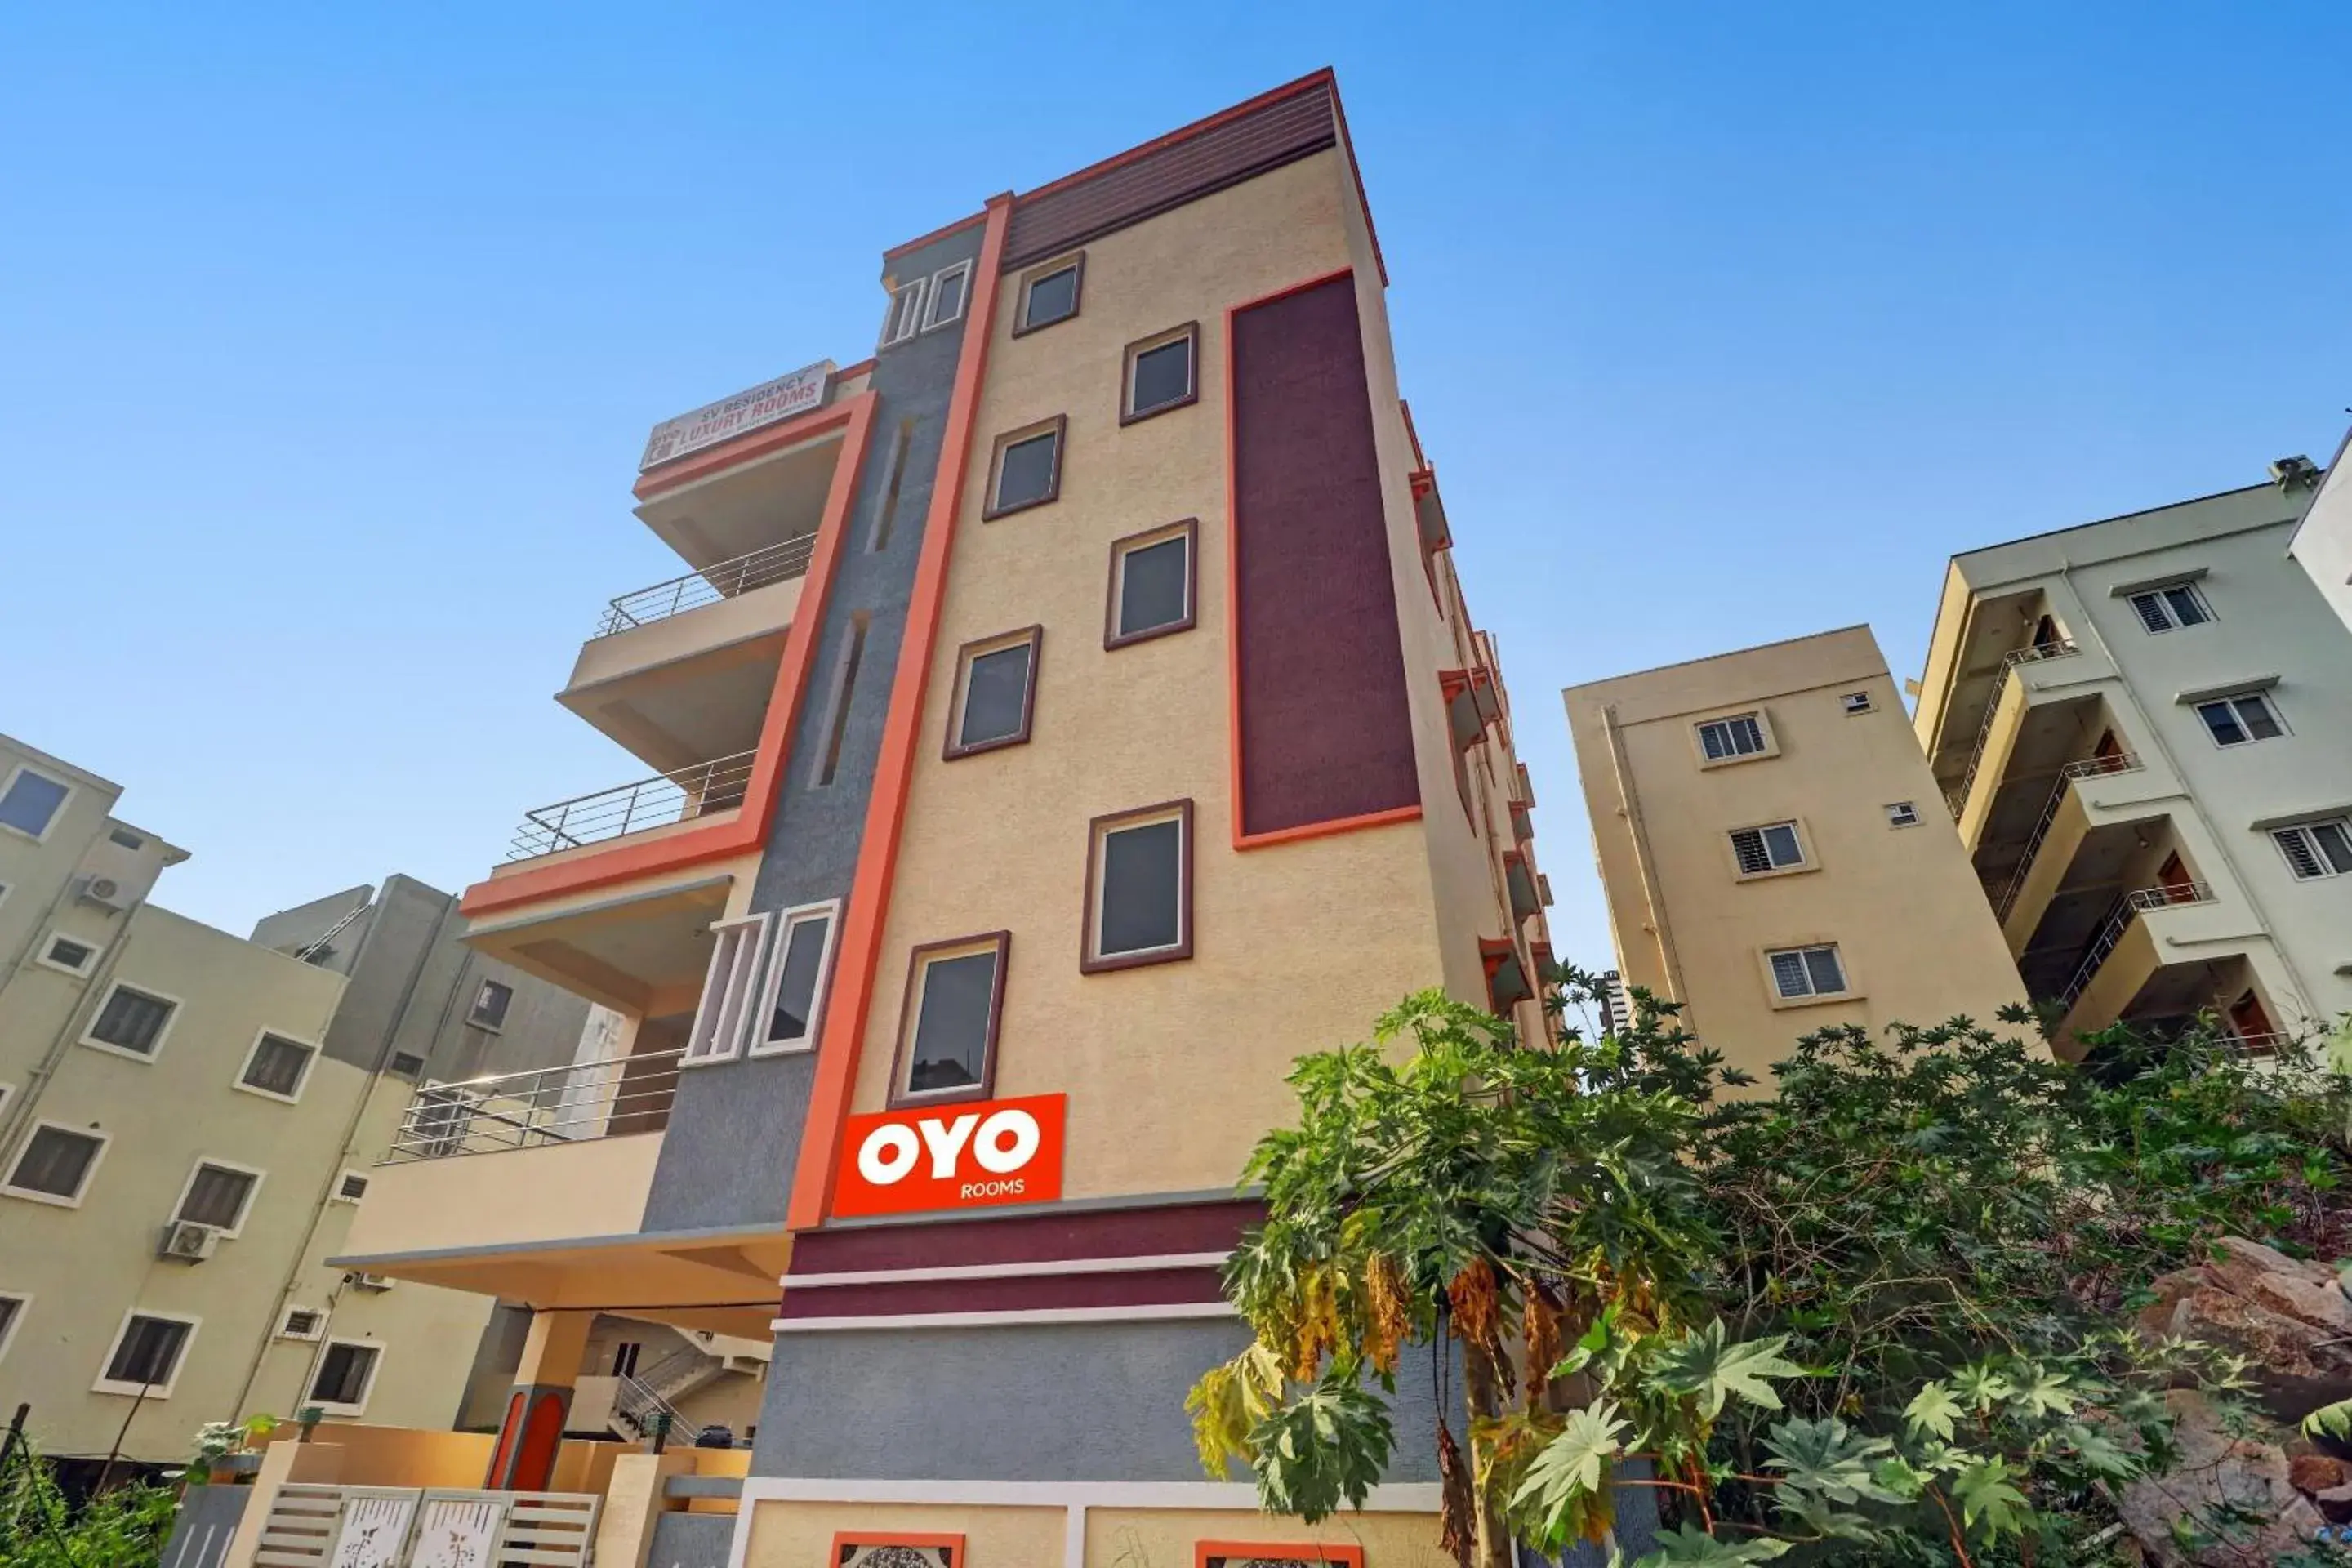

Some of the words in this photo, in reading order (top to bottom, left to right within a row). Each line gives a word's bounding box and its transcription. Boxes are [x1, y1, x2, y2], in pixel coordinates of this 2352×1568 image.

[679, 409, 746, 445] LUXURY
[752, 382, 817, 417] ROOMS
[701, 408, 721, 423] SV
[724, 374, 806, 412] RESIDENCY
[858, 1109, 1040, 1185] OYO
[960, 1178, 1025, 1199] ROOMS
